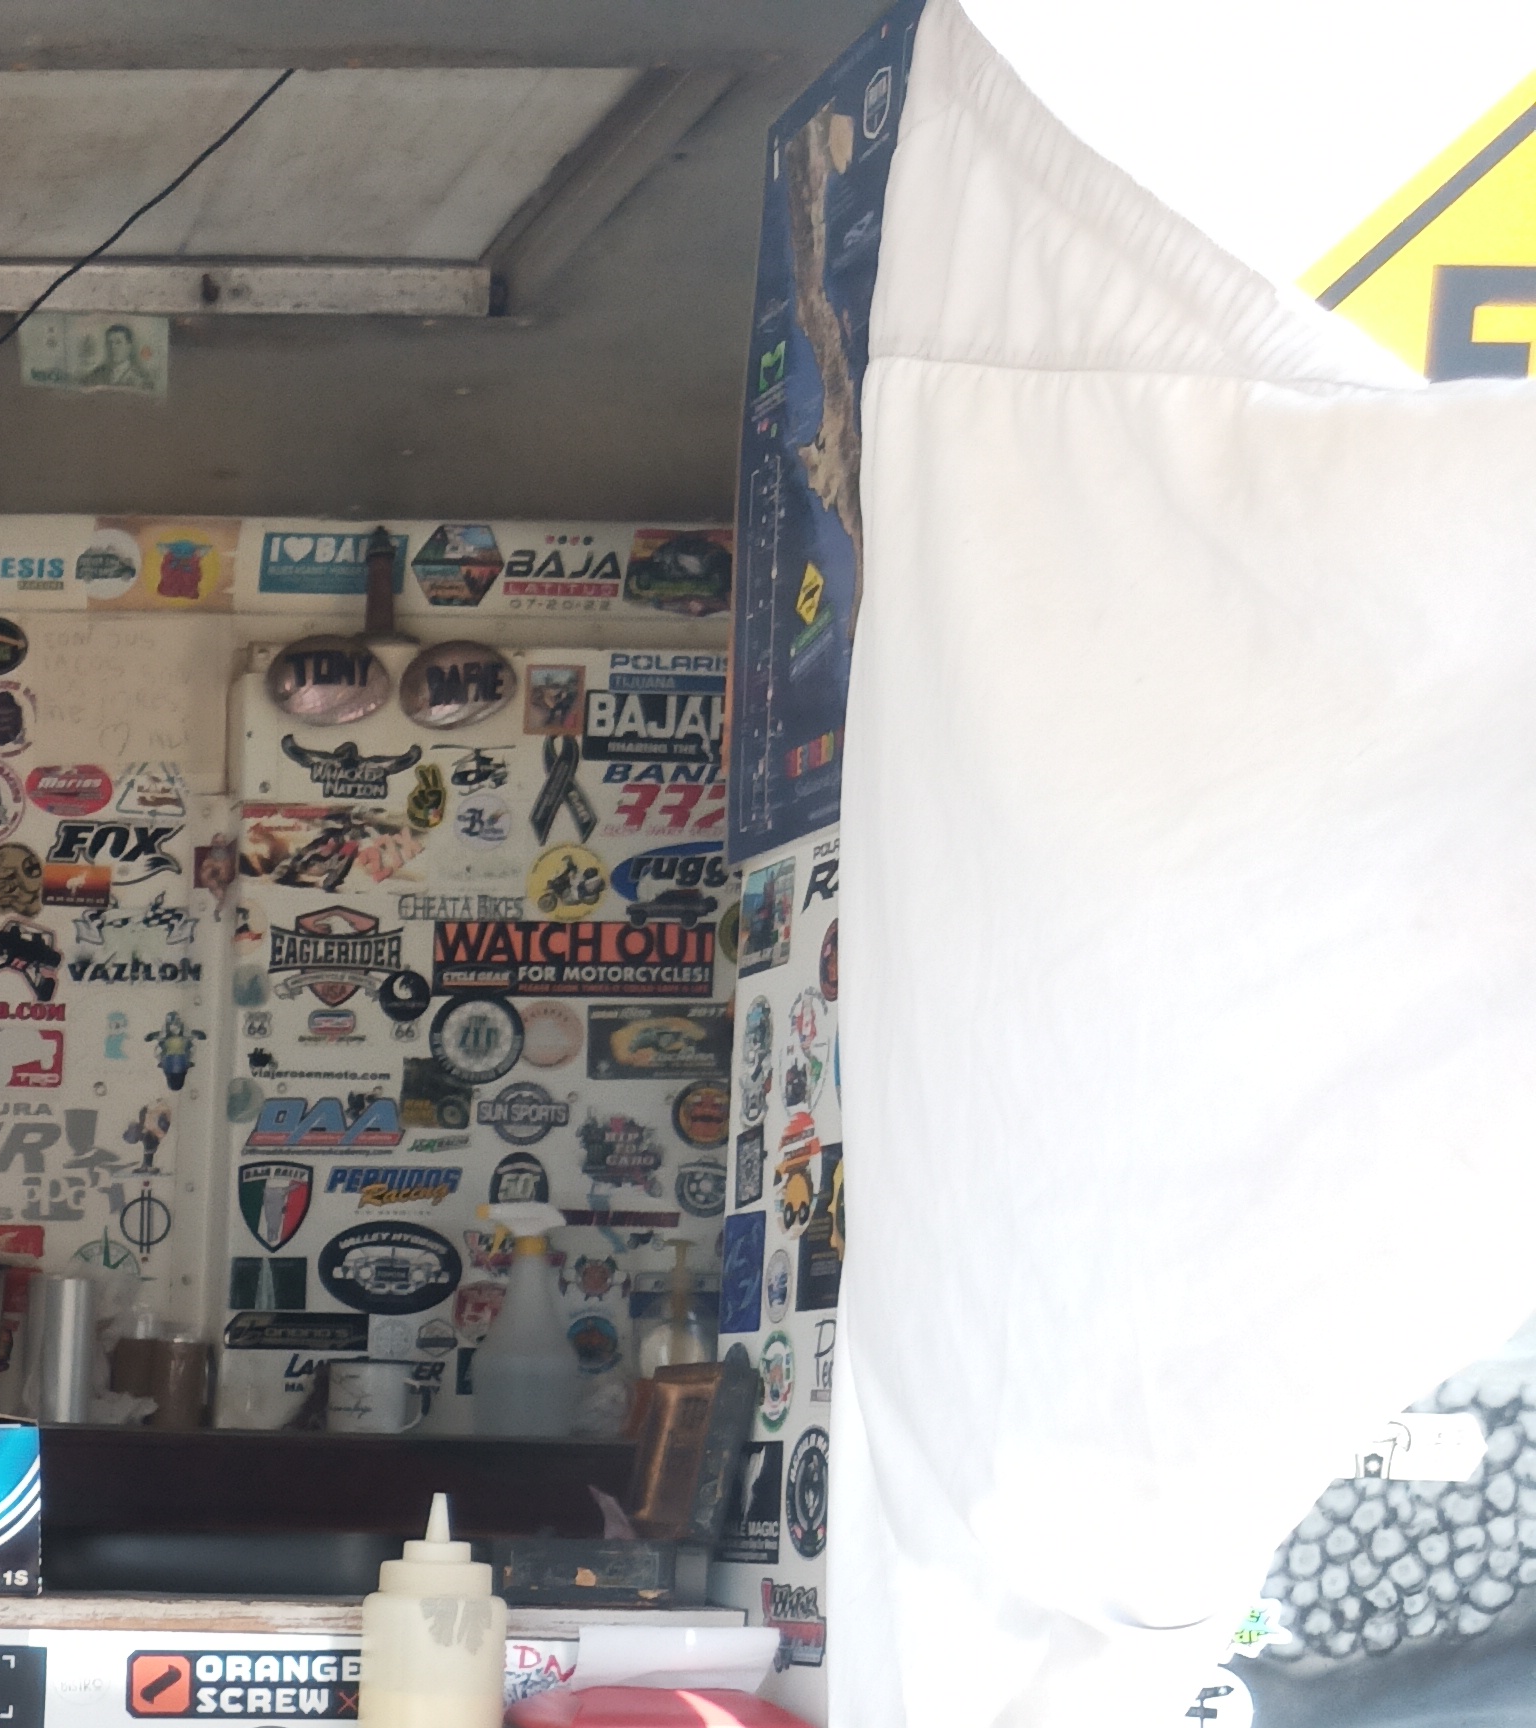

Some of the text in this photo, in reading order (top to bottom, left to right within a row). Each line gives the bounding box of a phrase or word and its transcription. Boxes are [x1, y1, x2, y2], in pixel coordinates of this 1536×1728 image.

[506, 549, 623, 580] BAJA
[613, 676, 677, 691] TIJUANA
[607, 740, 700, 756] SHARING THE
[323, 781, 388, 799] NATION
[46, 820, 184, 868] FOX
[269, 934, 404, 970] EAGLERIDER
[436, 922, 715, 965] WATCH OUT
[516, 964, 711, 984] FOR MOTORCYCLES!
[511, 1104, 569, 1124] SPORTS
[324, 1164, 464, 1194] PERDIDOS
[359, 1182, 452, 1210] Racing
[195, 1654, 362, 1683] ORANGE
[195, 1686, 329, 1715] SCREW
